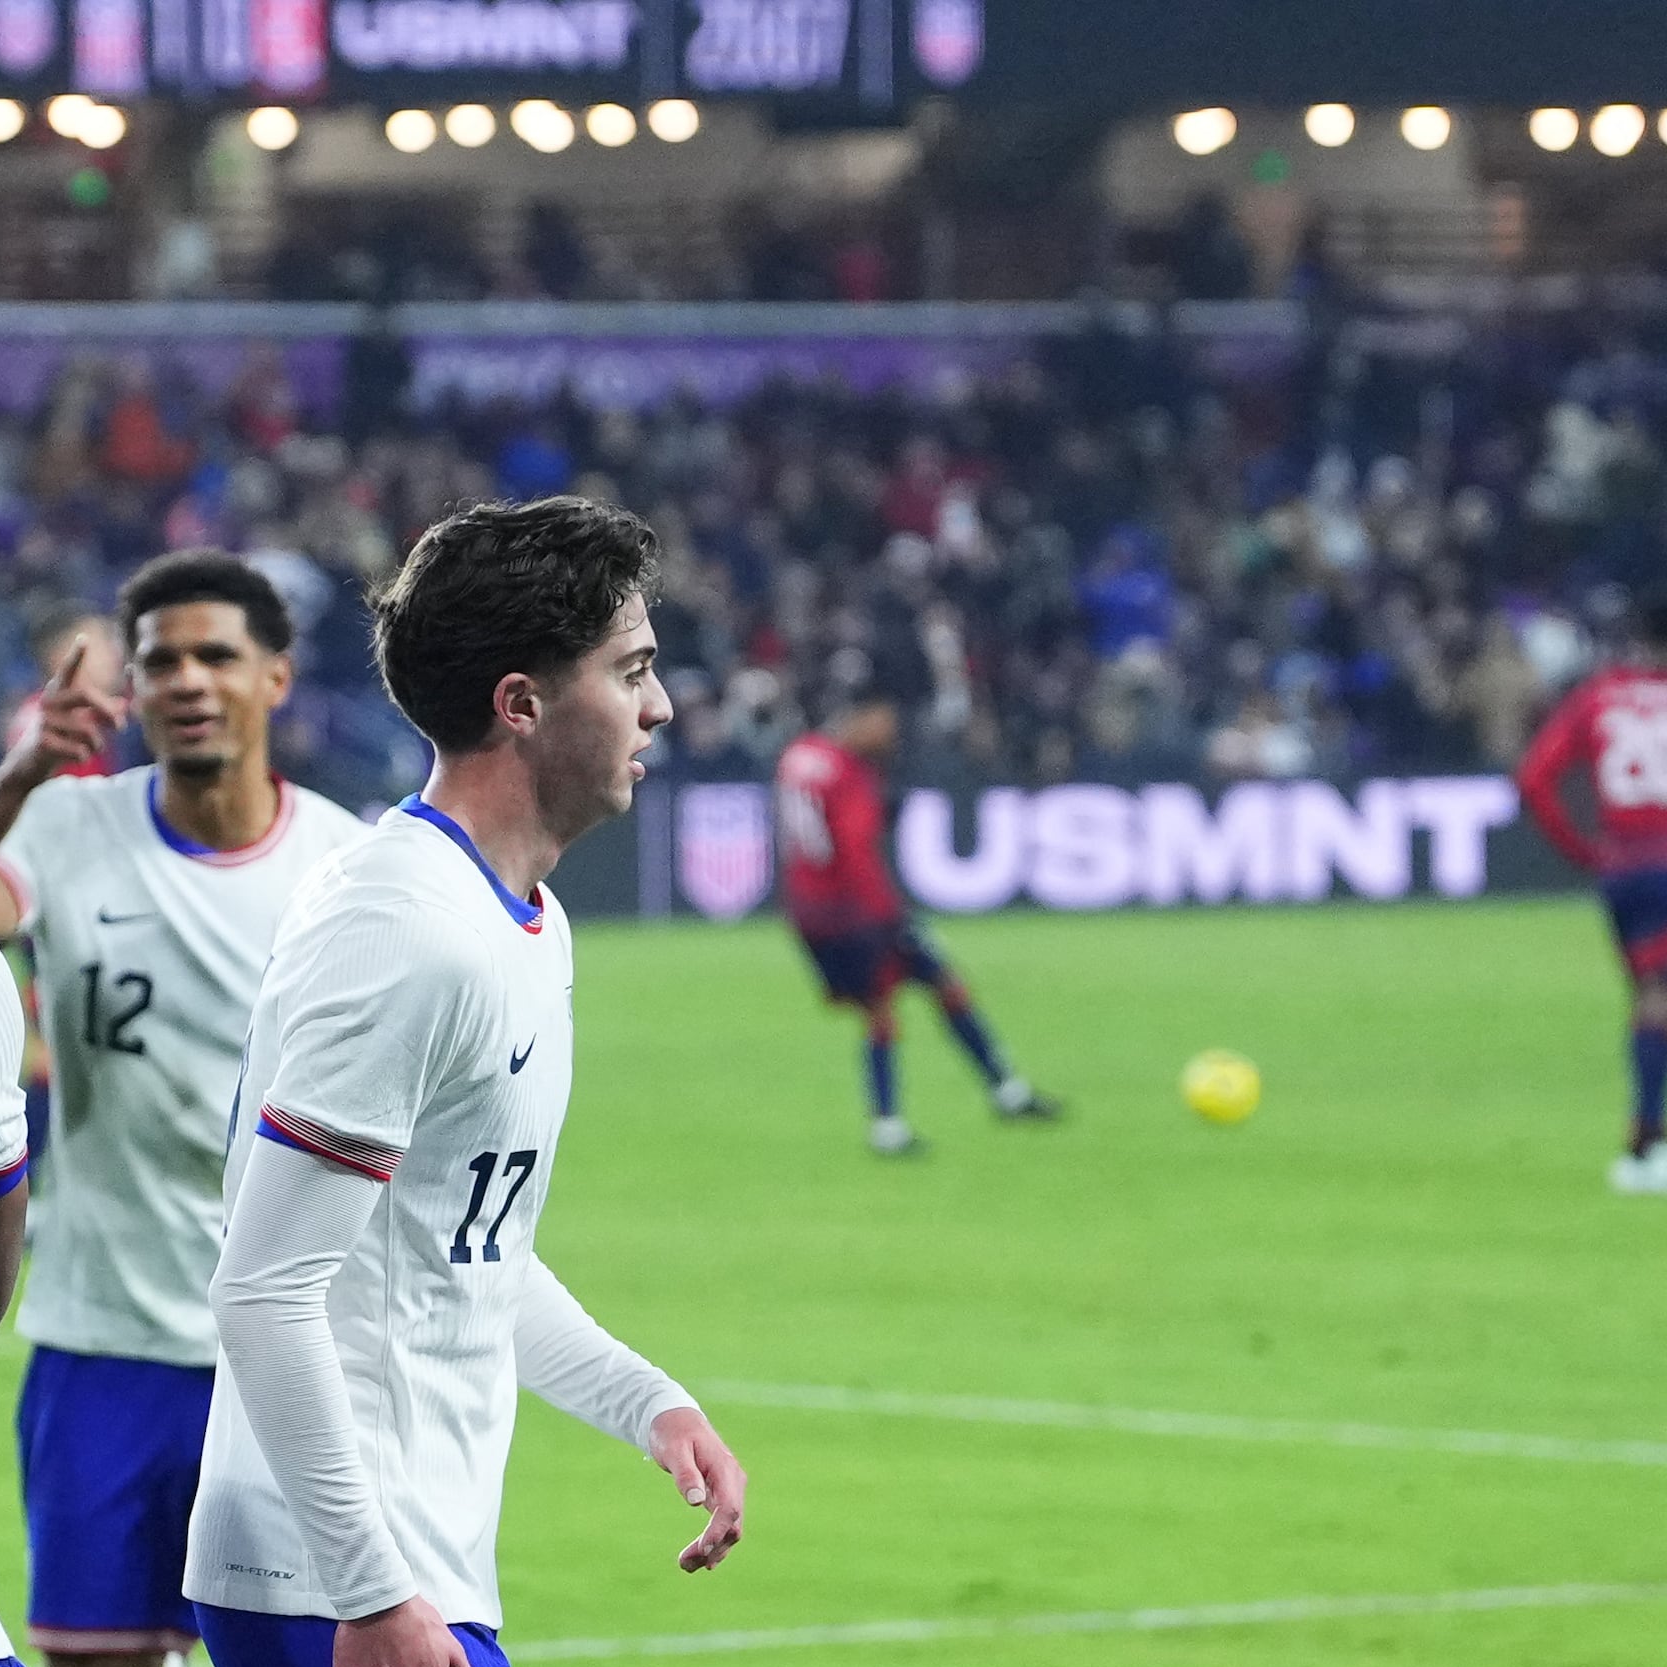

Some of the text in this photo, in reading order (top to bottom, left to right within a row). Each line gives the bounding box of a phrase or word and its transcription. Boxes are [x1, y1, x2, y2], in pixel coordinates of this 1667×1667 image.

[895, 776, 1519, 908] USMNT
[79, 961, 154, 1055] 12
[449, 1149, 538, 1264] 17
